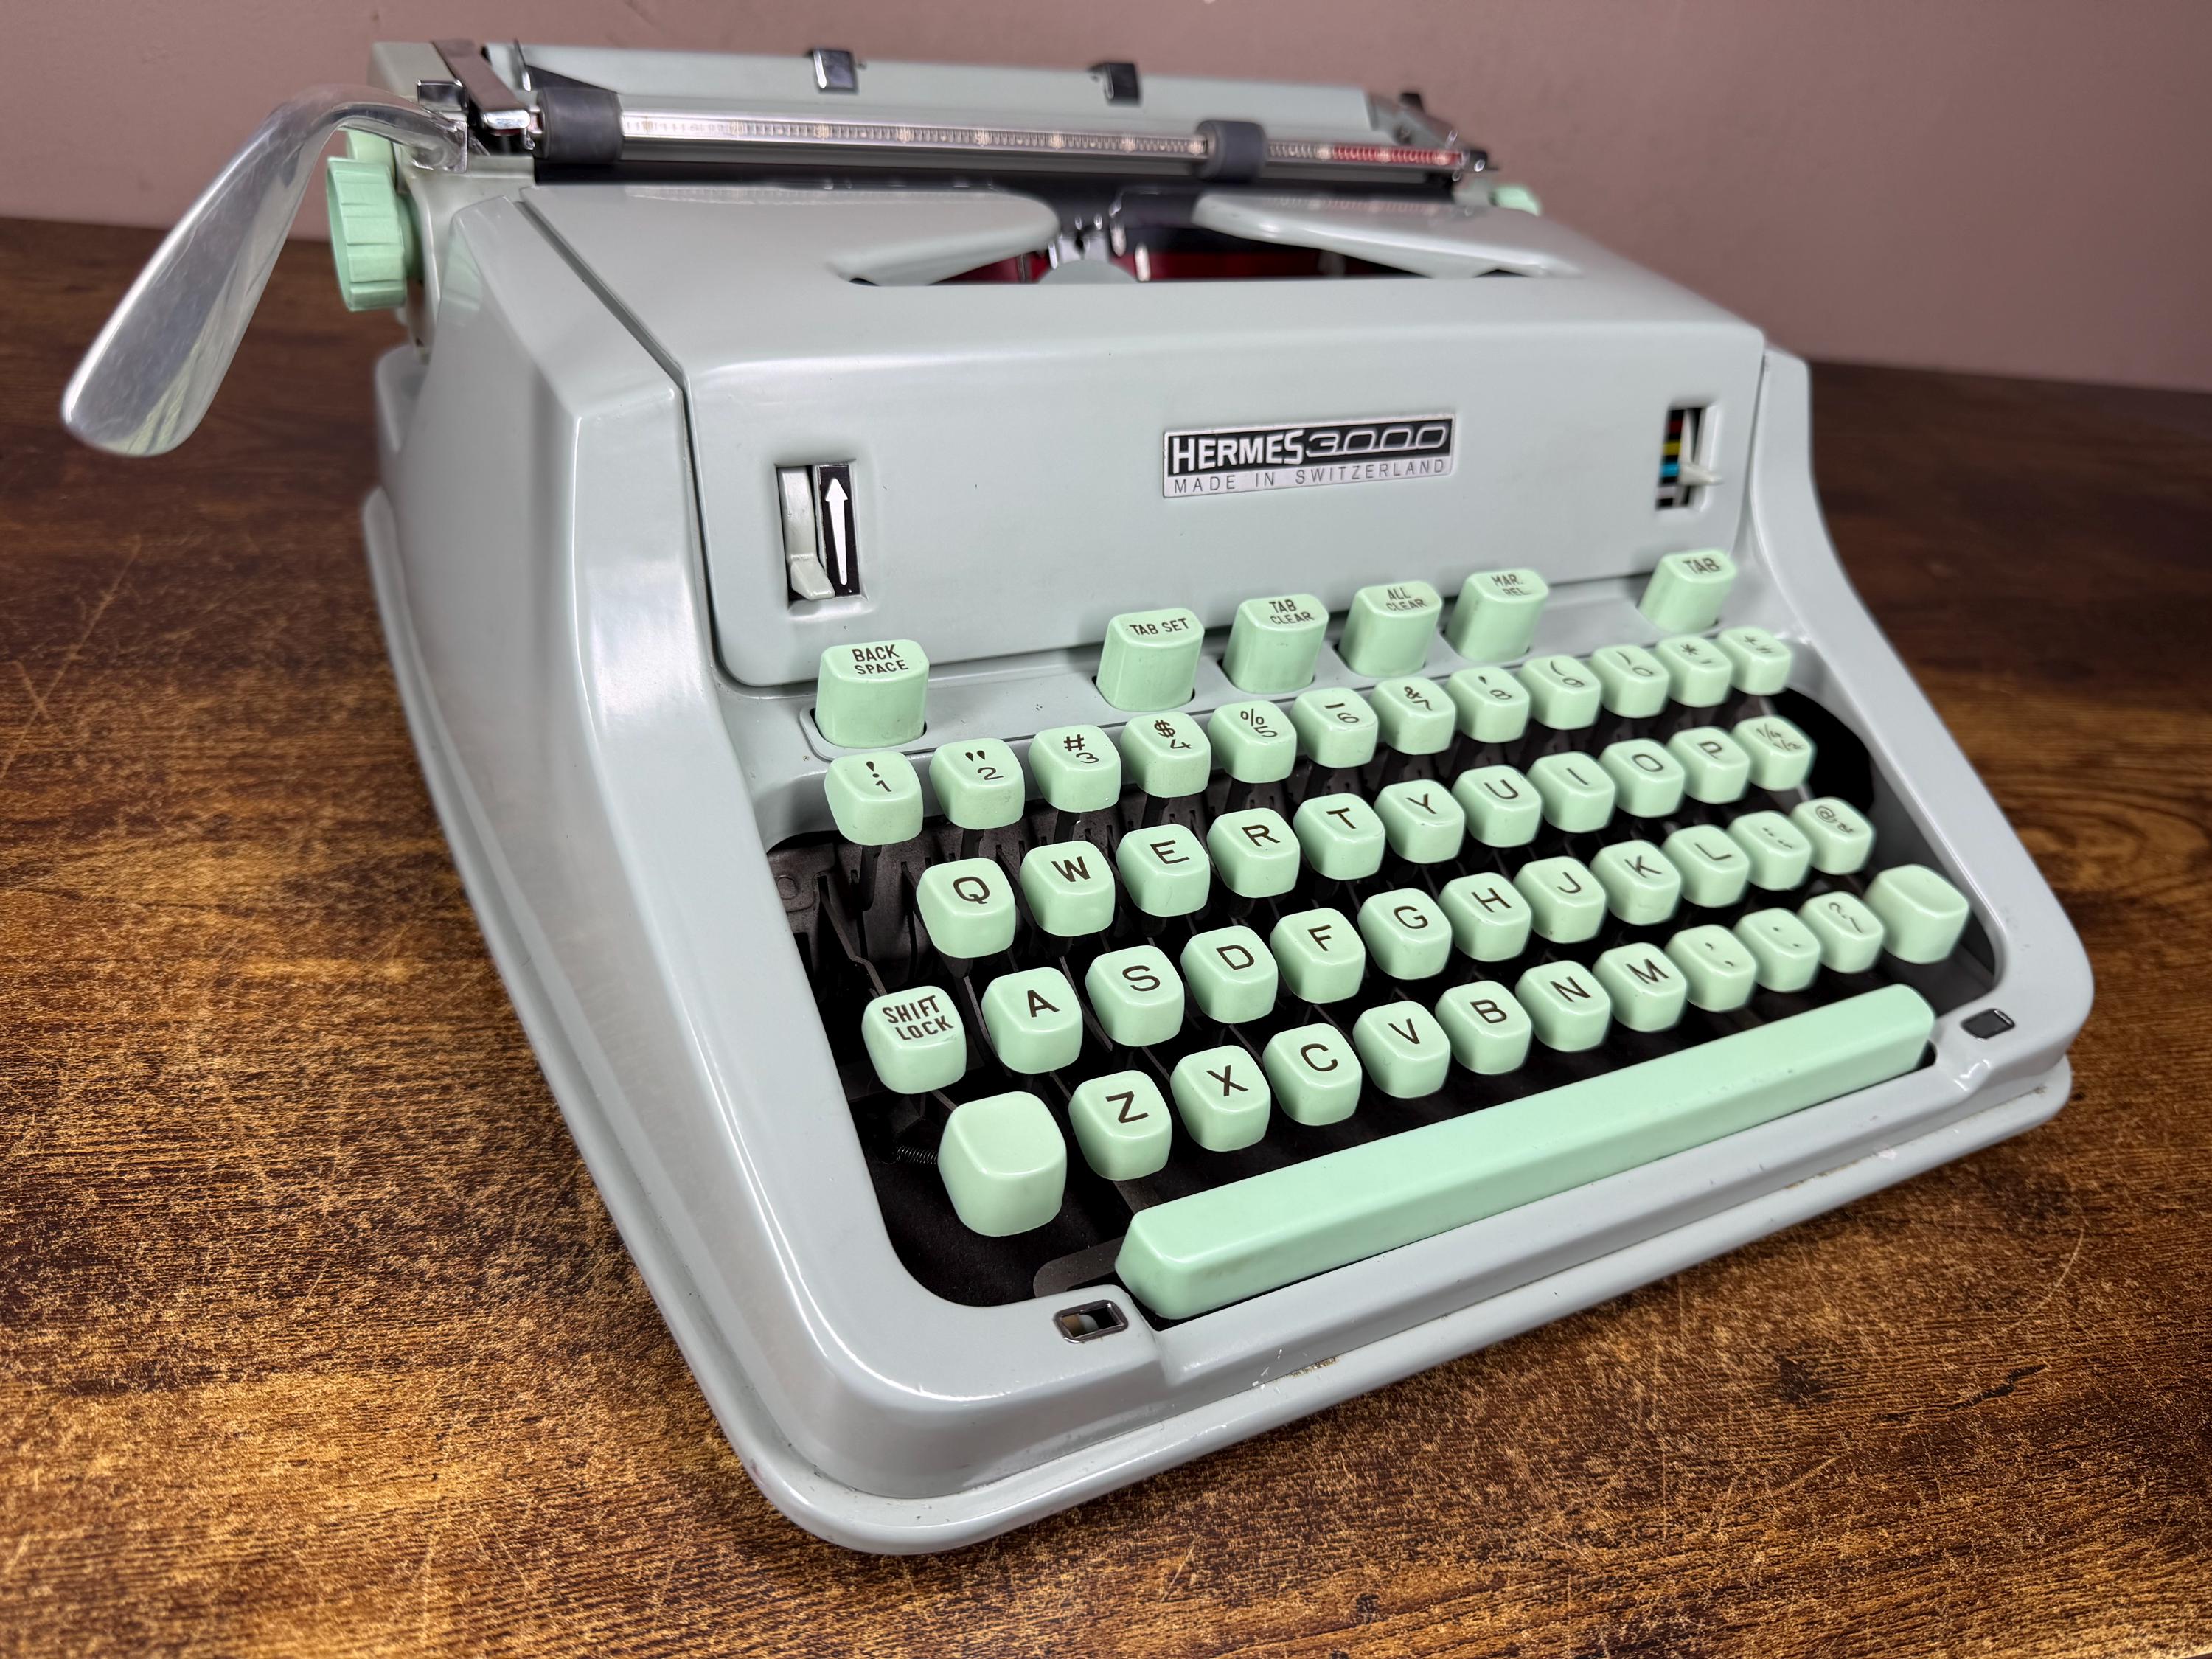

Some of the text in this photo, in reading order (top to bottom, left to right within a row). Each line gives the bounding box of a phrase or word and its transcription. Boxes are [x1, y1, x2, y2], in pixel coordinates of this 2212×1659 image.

[1172, 425, 1449, 474] HERMES 3000
[1174, 459, 1445, 493] MADE IN SWITZERLAND
[1682, 557, 1722, 575] TAB
[1386, 587, 1411, 601] ALL
[1269, 599, 1298, 613] TAB
[1385, 599, 1428, 612] CLEAR
[1129, 617, 1190, 636] TAB SET
[1270, 611, 1315, 625] CLEAR
[852, 644, 900, 663] BACK
[854, 659, 909, 675] SPACE
[1404, 686, 1422, 699] &
[1562, 678, 1585, 688] 9
[1489, 689, 1512, 700] 8
[1412, 699, 1433, 711] 7
[1240, 708, 1265, 727] %
[1337, 712, 1360, 723] 6
[1154, 719, 1176, 738] $
[1253, 726, 1278, 737] 5
[1063, 734, 1085, 752] #
[1170, 738, 1192, 749] 4
[1698, 741, 1722, 760] P
[1076, 752, 1099, 764] 3
[1632, 754, 1664, 772] O
[977, 767, 1004, 781] 2
[1566, 768, 1590, 786] I
[875, 779, 892, 793] 1
[1484, 779, 1519, 800] U
[1405, 793, 1437, 815] Y
[1326, 807, 1357, 830] T
[1815, 805, 1837, 824] @
[1241, 824, 1281, 847] R
[1150, 839, 1190, 865] E
[1694, 843, 1731, 860] L
[1051, 855, 1091, 883] W
[1624, 855, 1662, 878] K
[953, 876, 990, 905] Q
[1557, 871, 1582, 894] J
[1471, 887, 1512, 913] H
[1393, 905, 1429, 929] G
[1307, 924, 1332, 952] F
[1216, 945, 1255, 970] D
[1122, 965, 1161, 992] S
[1626, 958, 1669, 984] M
[1550, 976, 1591, 1002] N
[882, 995, 940, 1024] SHIFT
[1027, 990, 1060, 1018] A
[1470, 999, 1507, 1023] B
[895, 1015, 954, 1041] LOCK
[1388, 1018, 1420, 1045] V
[1300, 1043, 1338, 1072] C
[1206, 1064, 1249, 1096] X
[1105, 1091, 1149, 1124] Z
